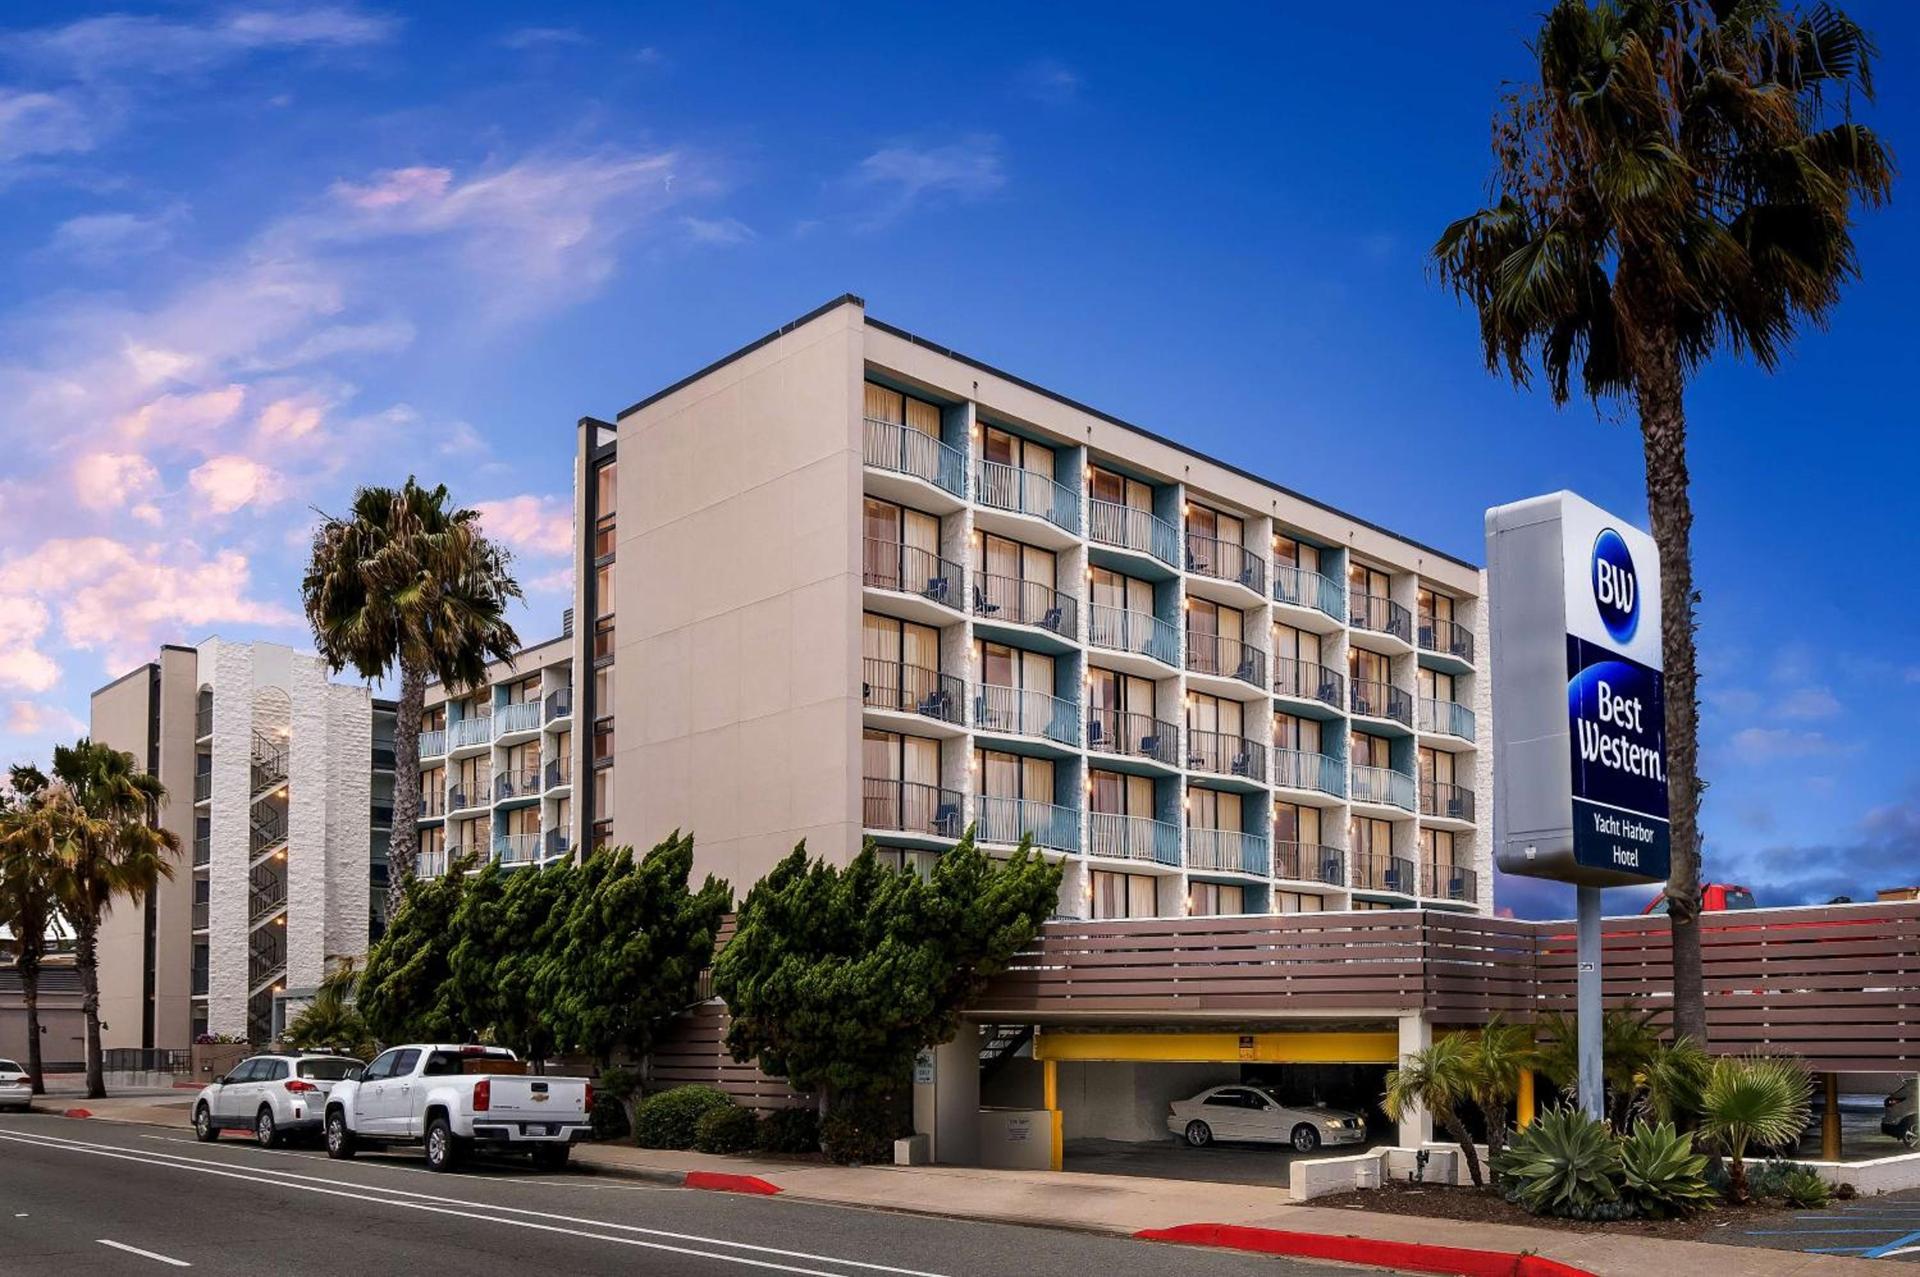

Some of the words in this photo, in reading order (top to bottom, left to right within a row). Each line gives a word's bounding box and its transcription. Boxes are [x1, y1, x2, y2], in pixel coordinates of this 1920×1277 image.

[1597, 557, 1634, 614] BW
[1598, 680, 1643, 734] Best
[1594, 812, 1621, 837] Yacht
[1622, 819, 1655, 843] Harbor
[1613, 845, 1640, 867] Hotel
